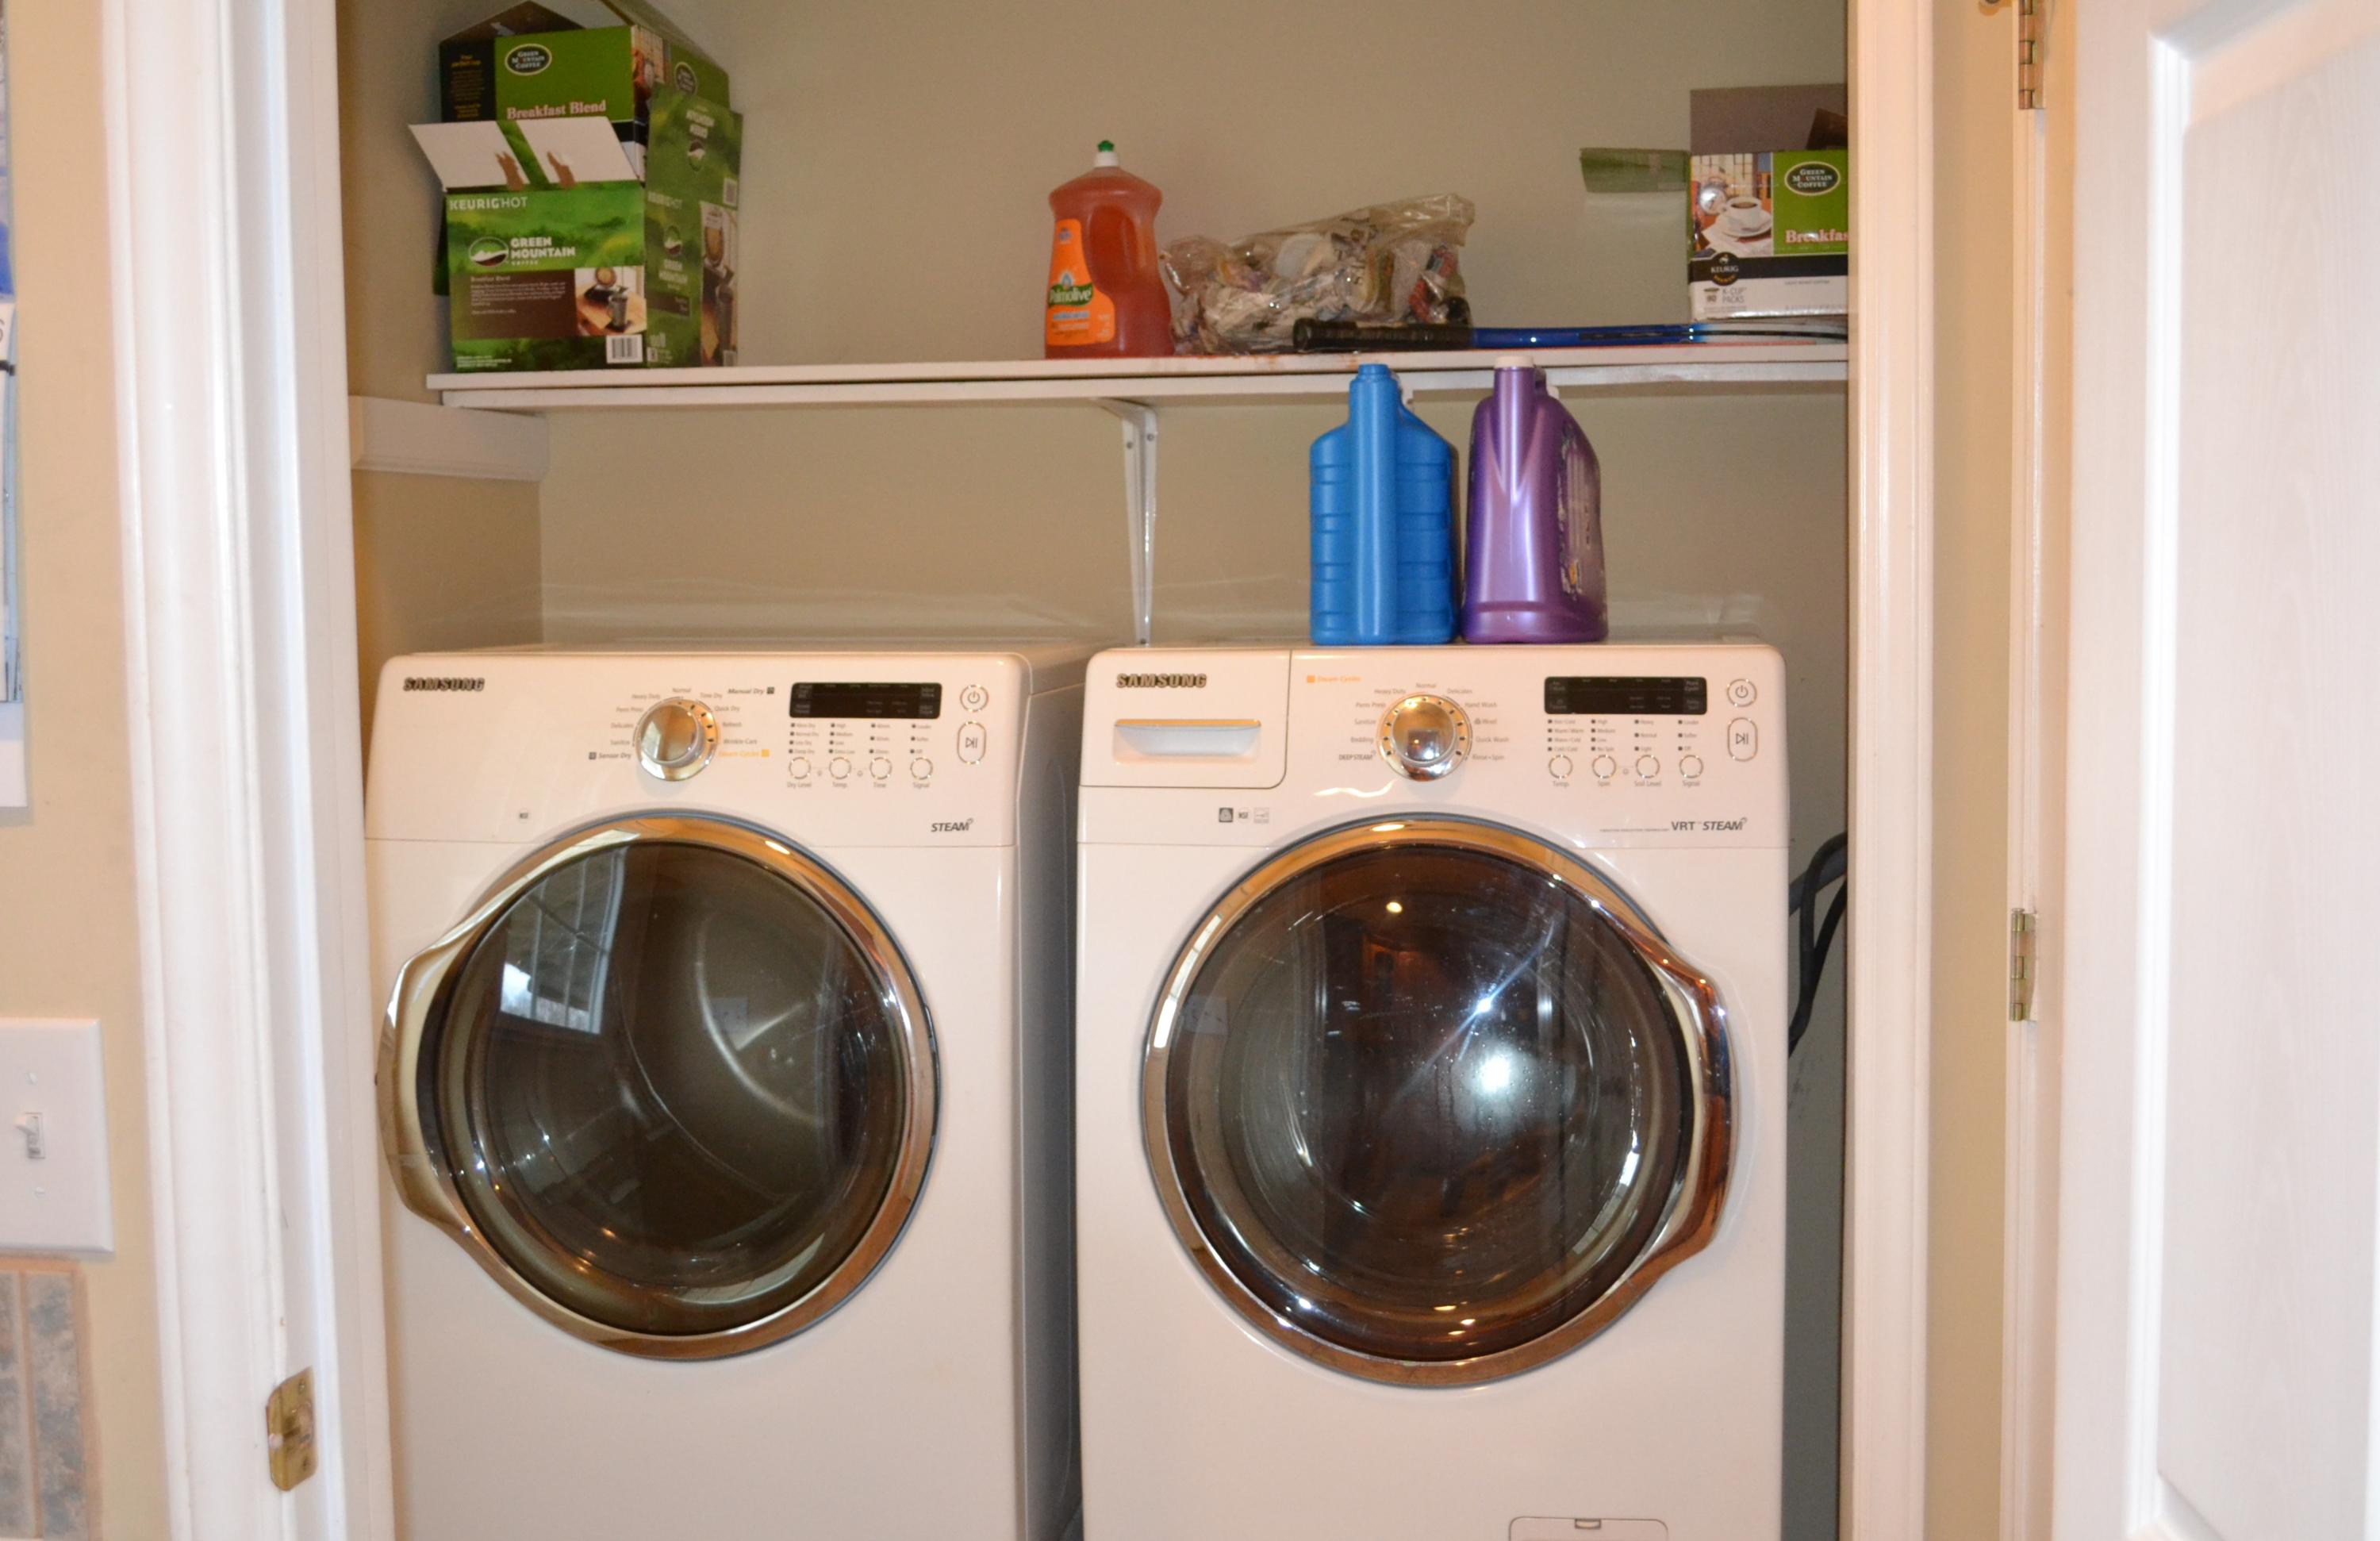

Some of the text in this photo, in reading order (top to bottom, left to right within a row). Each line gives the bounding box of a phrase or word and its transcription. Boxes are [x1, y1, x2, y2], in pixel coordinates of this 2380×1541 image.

[506, 100, 607, 120] Breakfast Blend
[449, 196, 528, 210] KEURIG HOT
[510, 236, 552, 248] GREEN
[510, 247, 576, 259] MOUNTAIN
[1710, 265, 1739, 274] KEURIG
[1049, 286, 1092, 303] Palmolive
[403, 677, 485, 692] SAMSUNG
[1115, 673, 1207, 689] SAMSUNG
[931, 821, 969, 832] STEAM
[1671, 820, 1695, 831] VRT
[1702, 820, 1745, 831] STEAM
